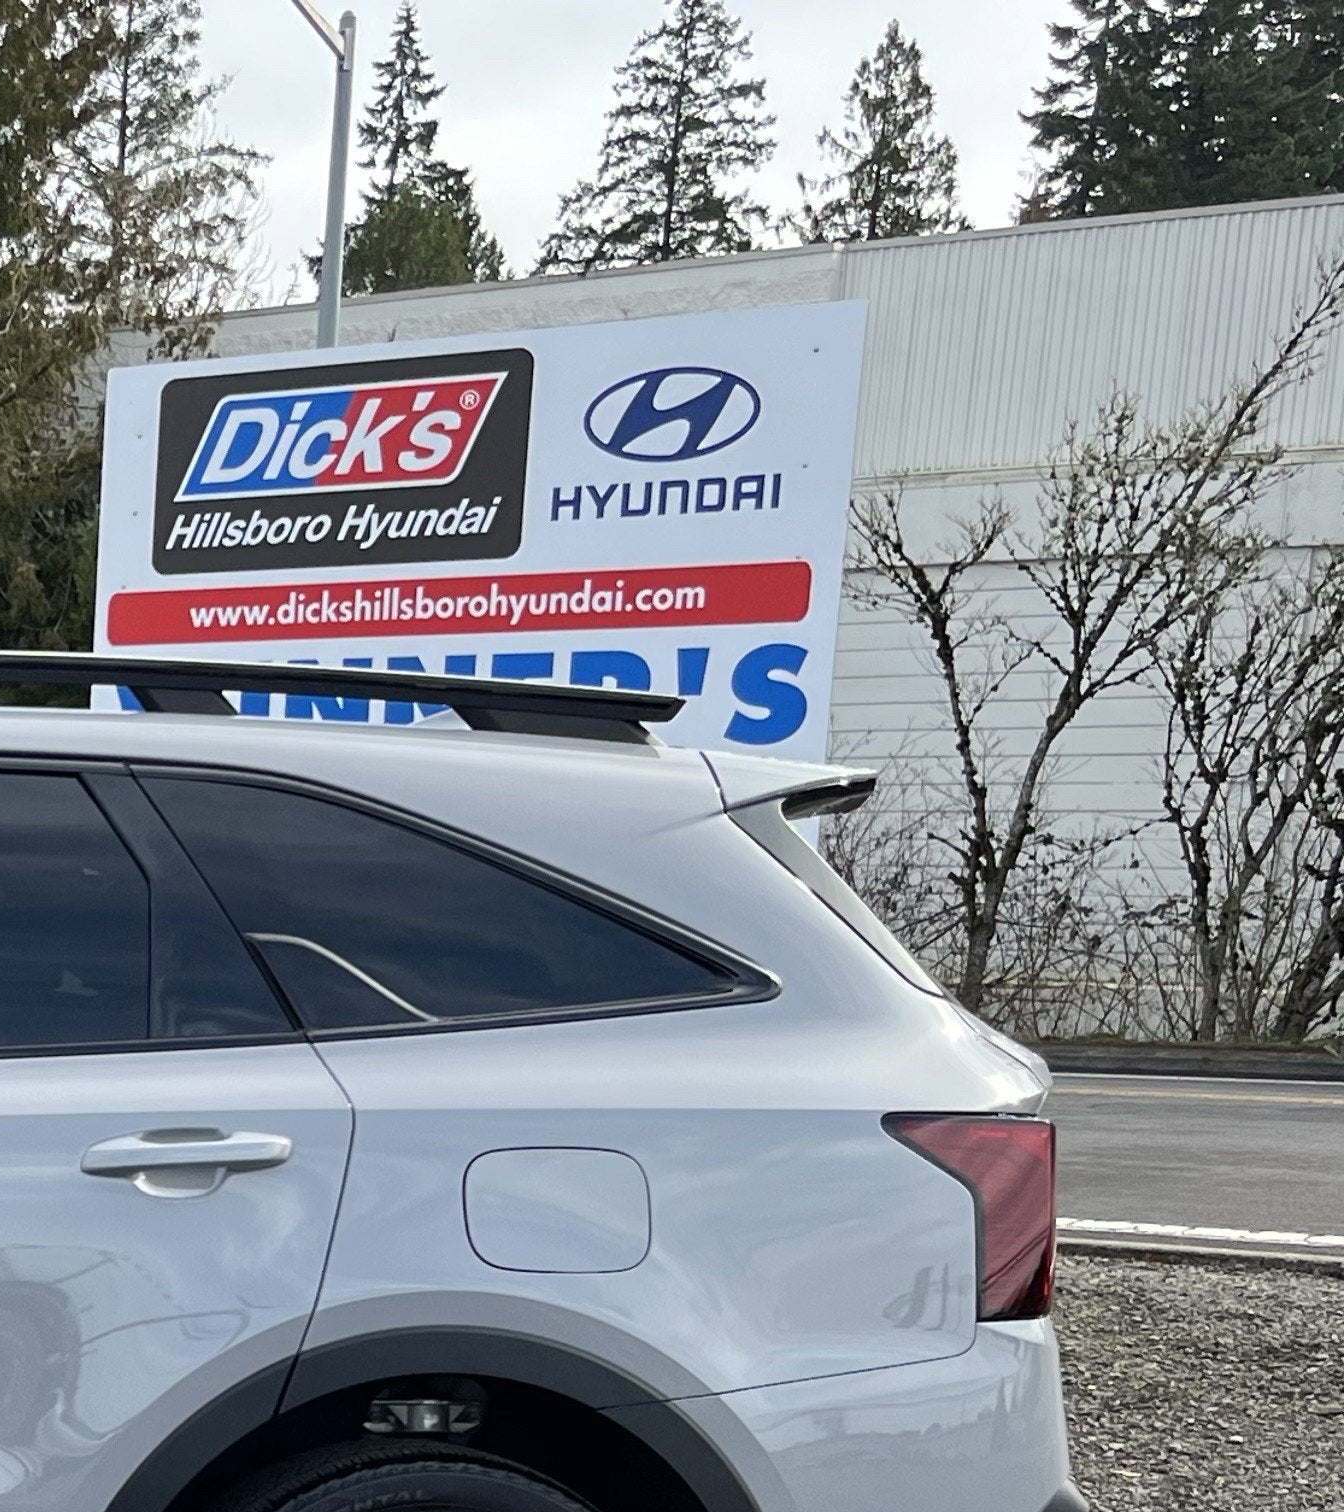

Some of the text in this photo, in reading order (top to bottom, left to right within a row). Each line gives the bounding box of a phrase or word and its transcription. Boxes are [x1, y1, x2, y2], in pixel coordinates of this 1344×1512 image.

[164, 494, 503, 550] Hillsboro Hyundai
[550, 472, 782, 522] HYUNDAI
[188, 579, 707, 628] www.dickshillsborohyundai.com
